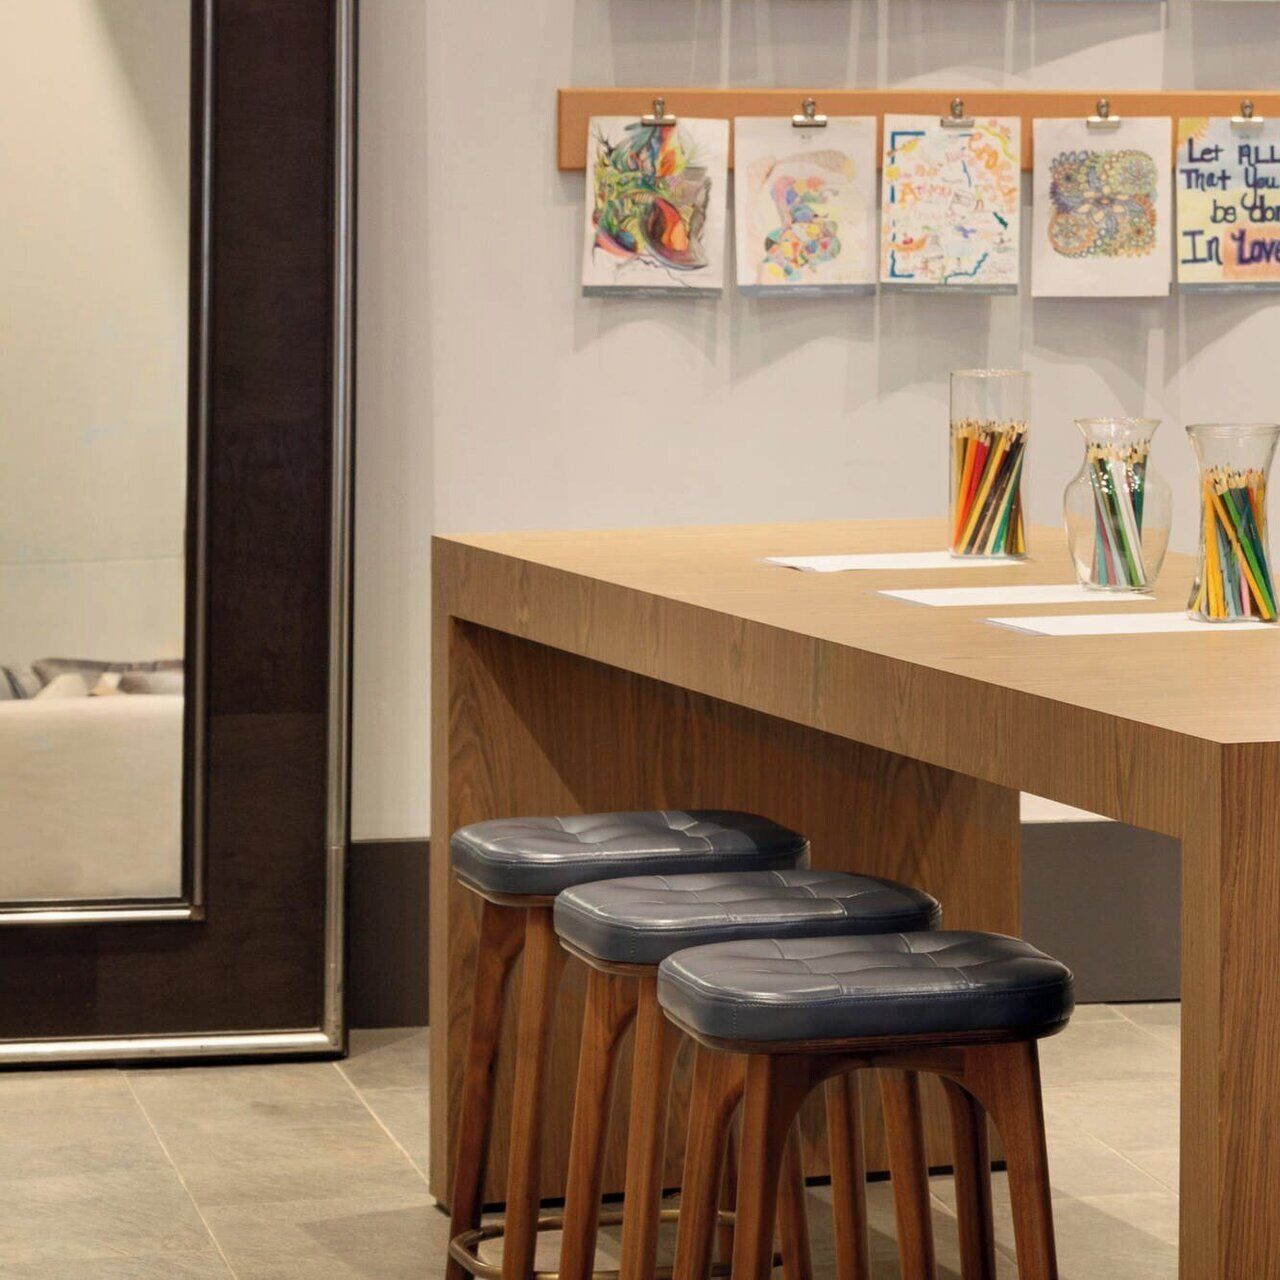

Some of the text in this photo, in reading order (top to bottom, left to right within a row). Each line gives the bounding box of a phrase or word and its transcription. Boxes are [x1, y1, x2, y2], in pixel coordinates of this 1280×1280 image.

[1180, 168, 1231, 192] That
[1210, 198, 1237, 224] be
[1181, 229, 1223, 266] In
